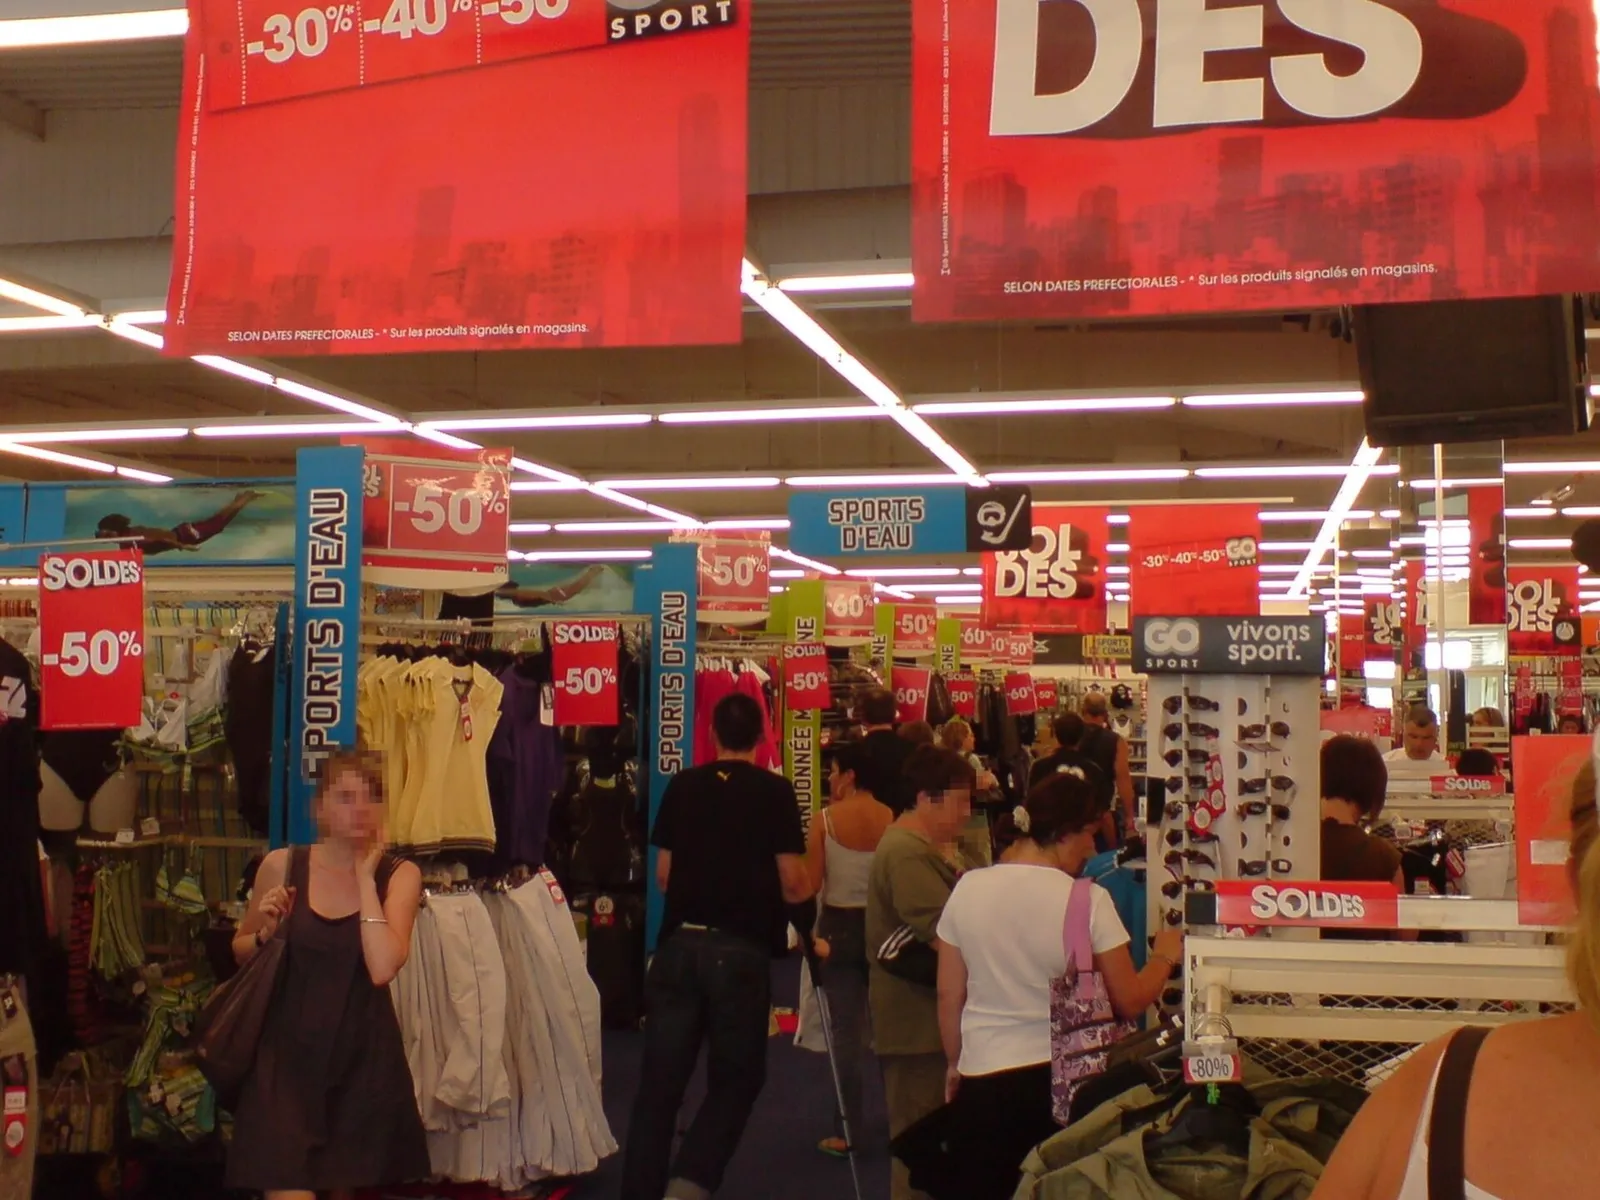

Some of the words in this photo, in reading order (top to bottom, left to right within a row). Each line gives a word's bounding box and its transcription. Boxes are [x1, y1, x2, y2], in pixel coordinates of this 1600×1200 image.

[610, 0, 731, 39] SPORT
[989, 0, 1422, 136] DES
[1003, 281, 1043, 294] SELON
[1046, 279, 1080, 292] DATES
[1084, 276, 1178, 291] PREFECTORALES
[1199, 273, 1218, 286] Sur
[1221, 272, 1238, 285] les
[1241, 269, 1293, 286] produits
[1295, 266, 1348, 284] signalés
[1351, 269, 1368, 280] en
[1371, 262, 1438, 279] magasins.
[227, 331, 260, 342] SELON
[263, 330, 292, 341] DATES
[295, 328, 374, 341] PREFECTORALES
[390, 327, 407, 339] Sur
[409, 326, 423, 338] les
[425, 325, 468, 339] produits
[470, 323, 514, 338] signalés
[516, 324, 531, 334] en
[394, 484, 505, 535] -50%
[827, 495, 925, 524] SPORTS
[307, 488, 348, 608] D'EAU
[841, 524, 913, 553] D'EAU
[995, 522, 1082, 563] OL
[1226, 537, 1257, 559] GO
[555, 623, 616, 644] SOLDES
[660, 590, 688, 668] D'EAU
[1144, 617, 1200, 656] GO
[1227, 620, 1311, 642] vivons
[42, 629, 142, 677] -50%
[1146, 658, 1199, 668] SPORT
[1228, 640, 1302, 666] sport.
[555, 667, 616, 695] -50%
[786, 672, 828, 691] -50%
[303, 618, 343, 784] PORTS
[658, 671, 686, 775] SPORTS
[788, 726, 816, 846] ANDONNÉE
[1444, 777, 1491, 791] SOLDES
[1251, 884, 1366, 919] SOLDES
[1192, 1057, 1229, 1078] -80%
